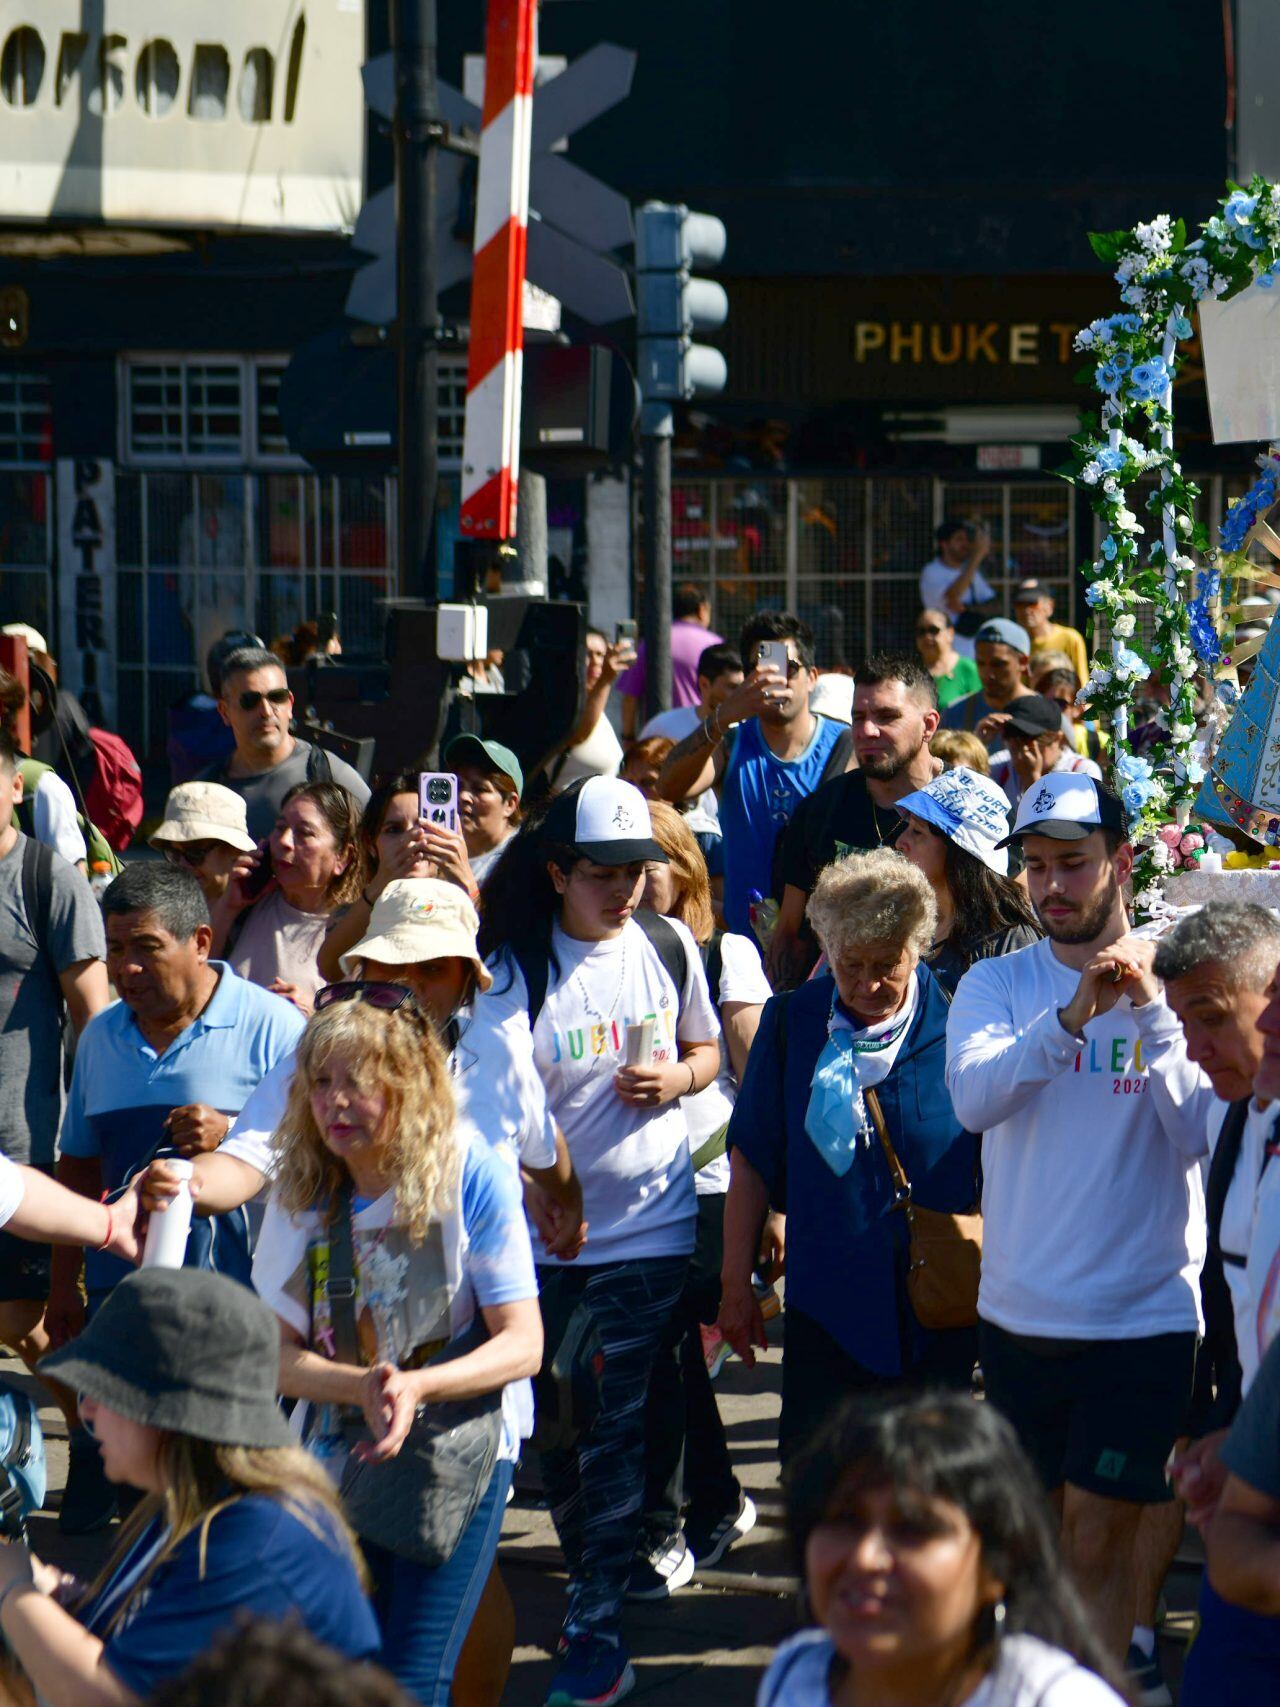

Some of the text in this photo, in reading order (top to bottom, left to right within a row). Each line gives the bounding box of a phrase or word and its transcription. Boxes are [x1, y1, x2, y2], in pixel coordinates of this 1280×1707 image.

[855, 321, 1078, 364] PHUKET
[932, 789, 965, 817] VILLA
[977, 804, 998, 819] DE
